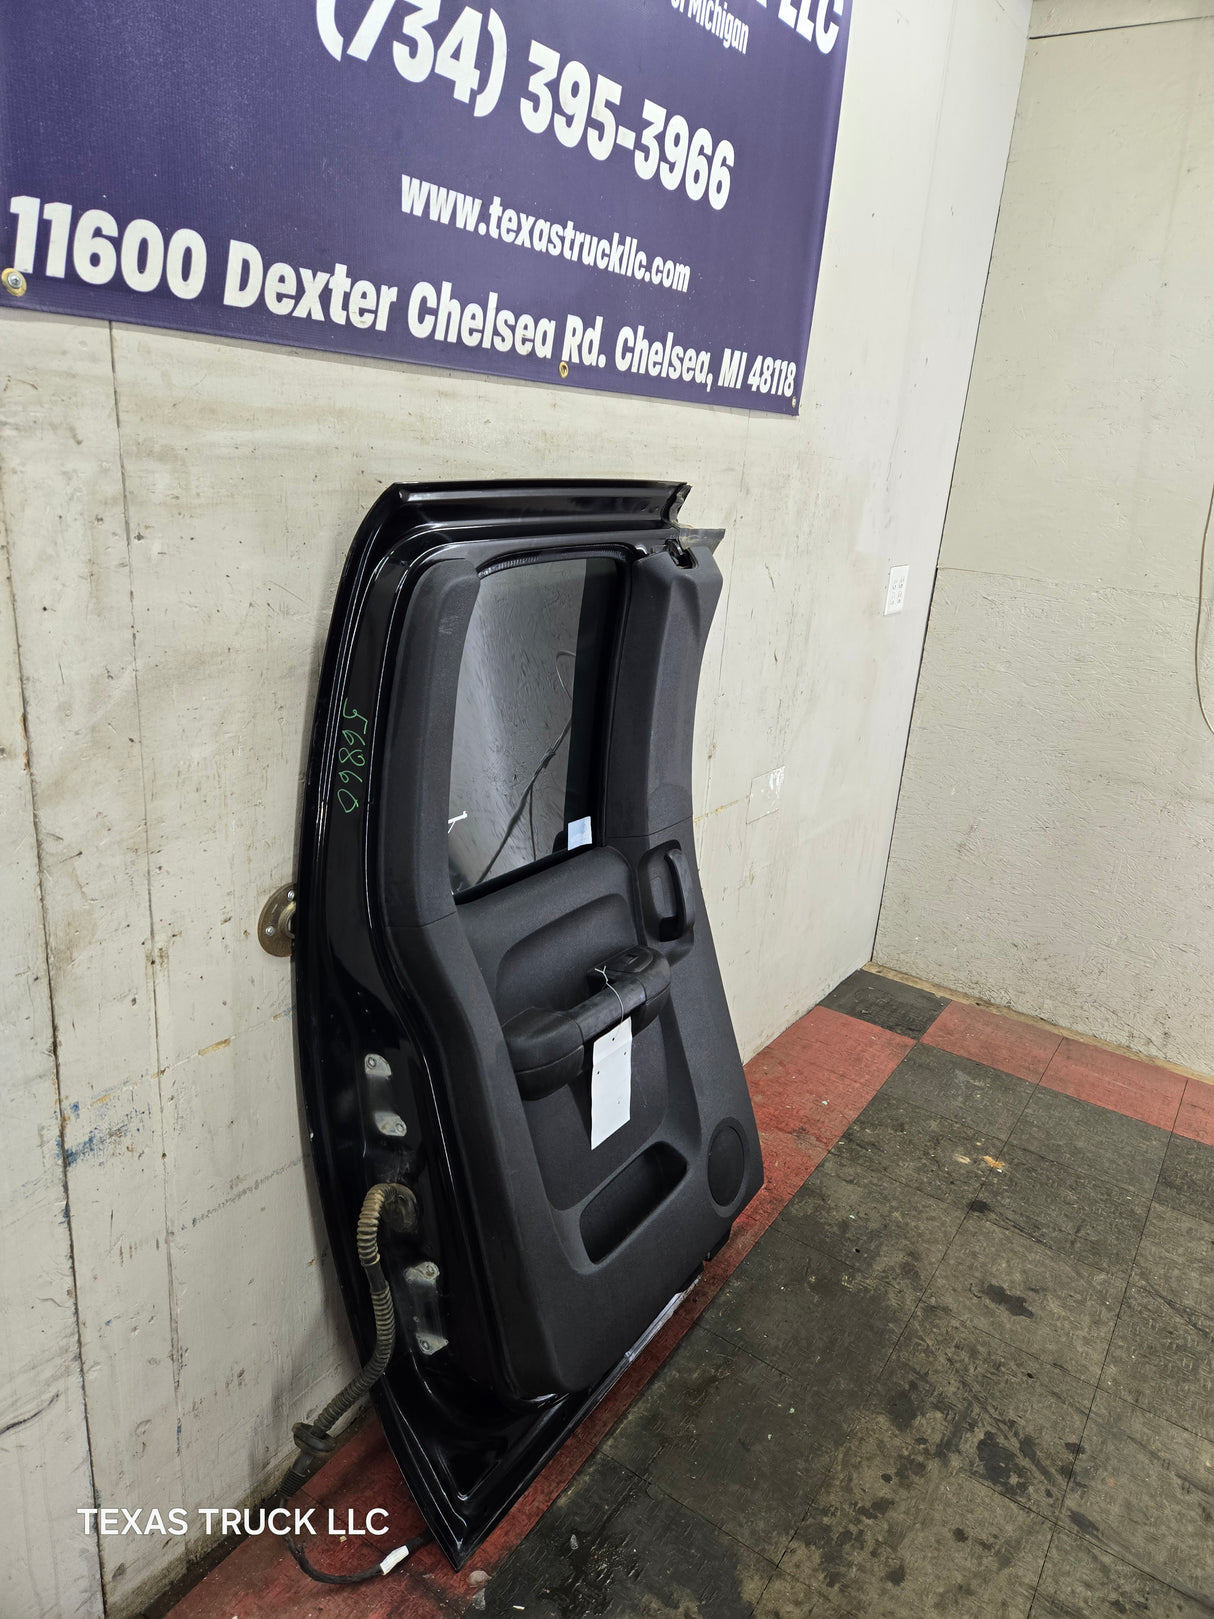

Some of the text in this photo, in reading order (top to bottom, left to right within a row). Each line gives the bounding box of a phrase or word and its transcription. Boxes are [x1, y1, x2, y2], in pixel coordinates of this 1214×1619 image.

[520, 40, 735, 211] 395-3966
[8, 195, 797, 398] 11600 Dexter Chelsea Rd. Chelsea, MI 48118
[401, 175, 691, 293] www.texastruckllc.com
[337, 698, 368, 813] 56860
